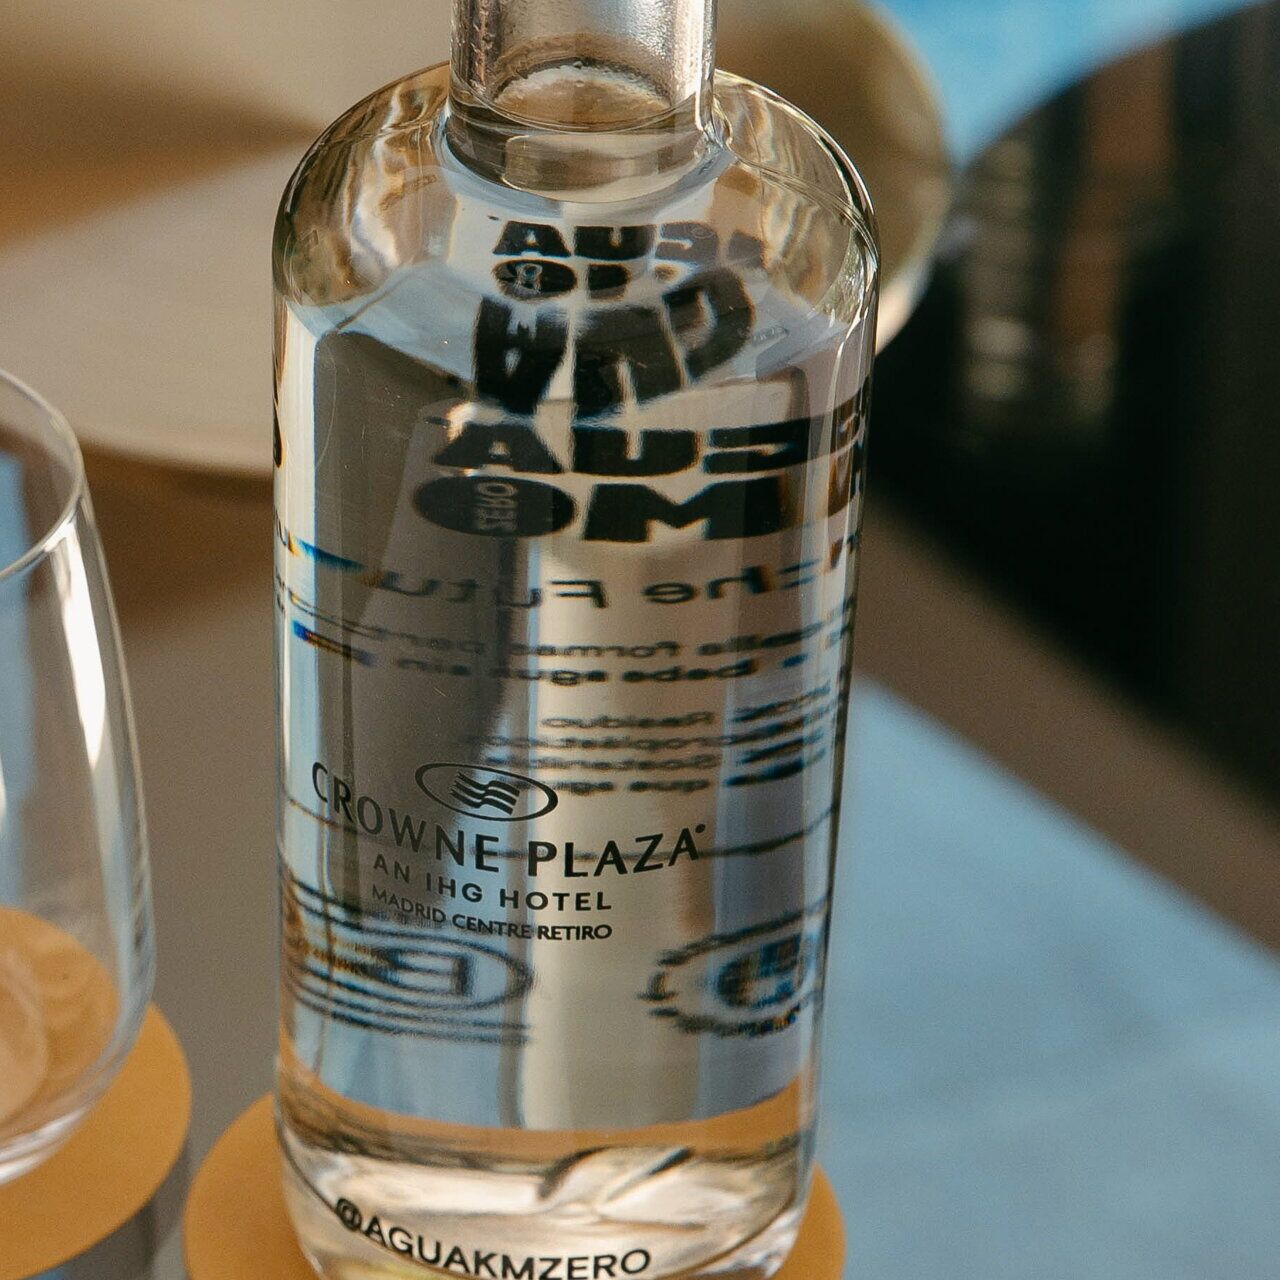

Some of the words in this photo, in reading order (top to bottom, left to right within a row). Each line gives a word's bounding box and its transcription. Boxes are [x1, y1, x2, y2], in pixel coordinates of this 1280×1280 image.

[312, 762, 499, 873] CROWNE
[527, 825, 701, 878] PLAZA
[373, 854, 410, 884] AN
[426, 877, 483, 903] IHG
[500, 888, 612, 912] HOTEL
[372, 884, 447, 924] MADRID
[451, 914, 532, 940] CENTRE
[537, 924, 613, 941] RETIRO
